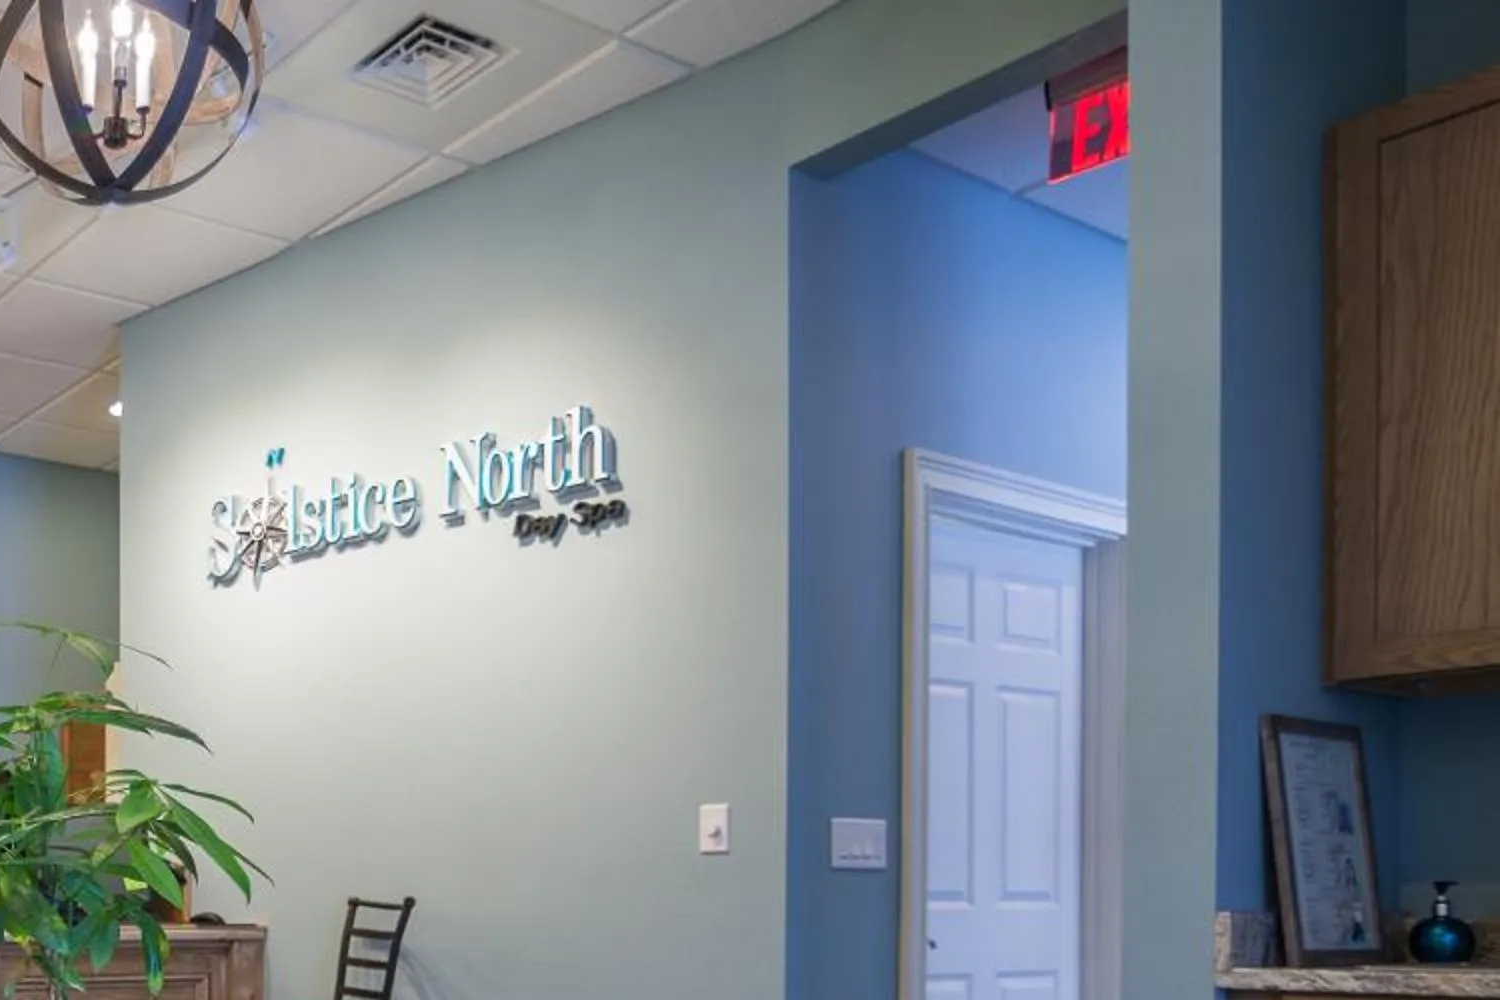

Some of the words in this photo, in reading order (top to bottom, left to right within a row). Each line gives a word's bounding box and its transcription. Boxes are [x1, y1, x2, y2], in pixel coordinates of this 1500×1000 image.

[1072, 82, 1130, 173] EX
[440, 404, 620, 518] North
[513, 513, 567, 540] Day
[569, 499, 628, 530] Spa
